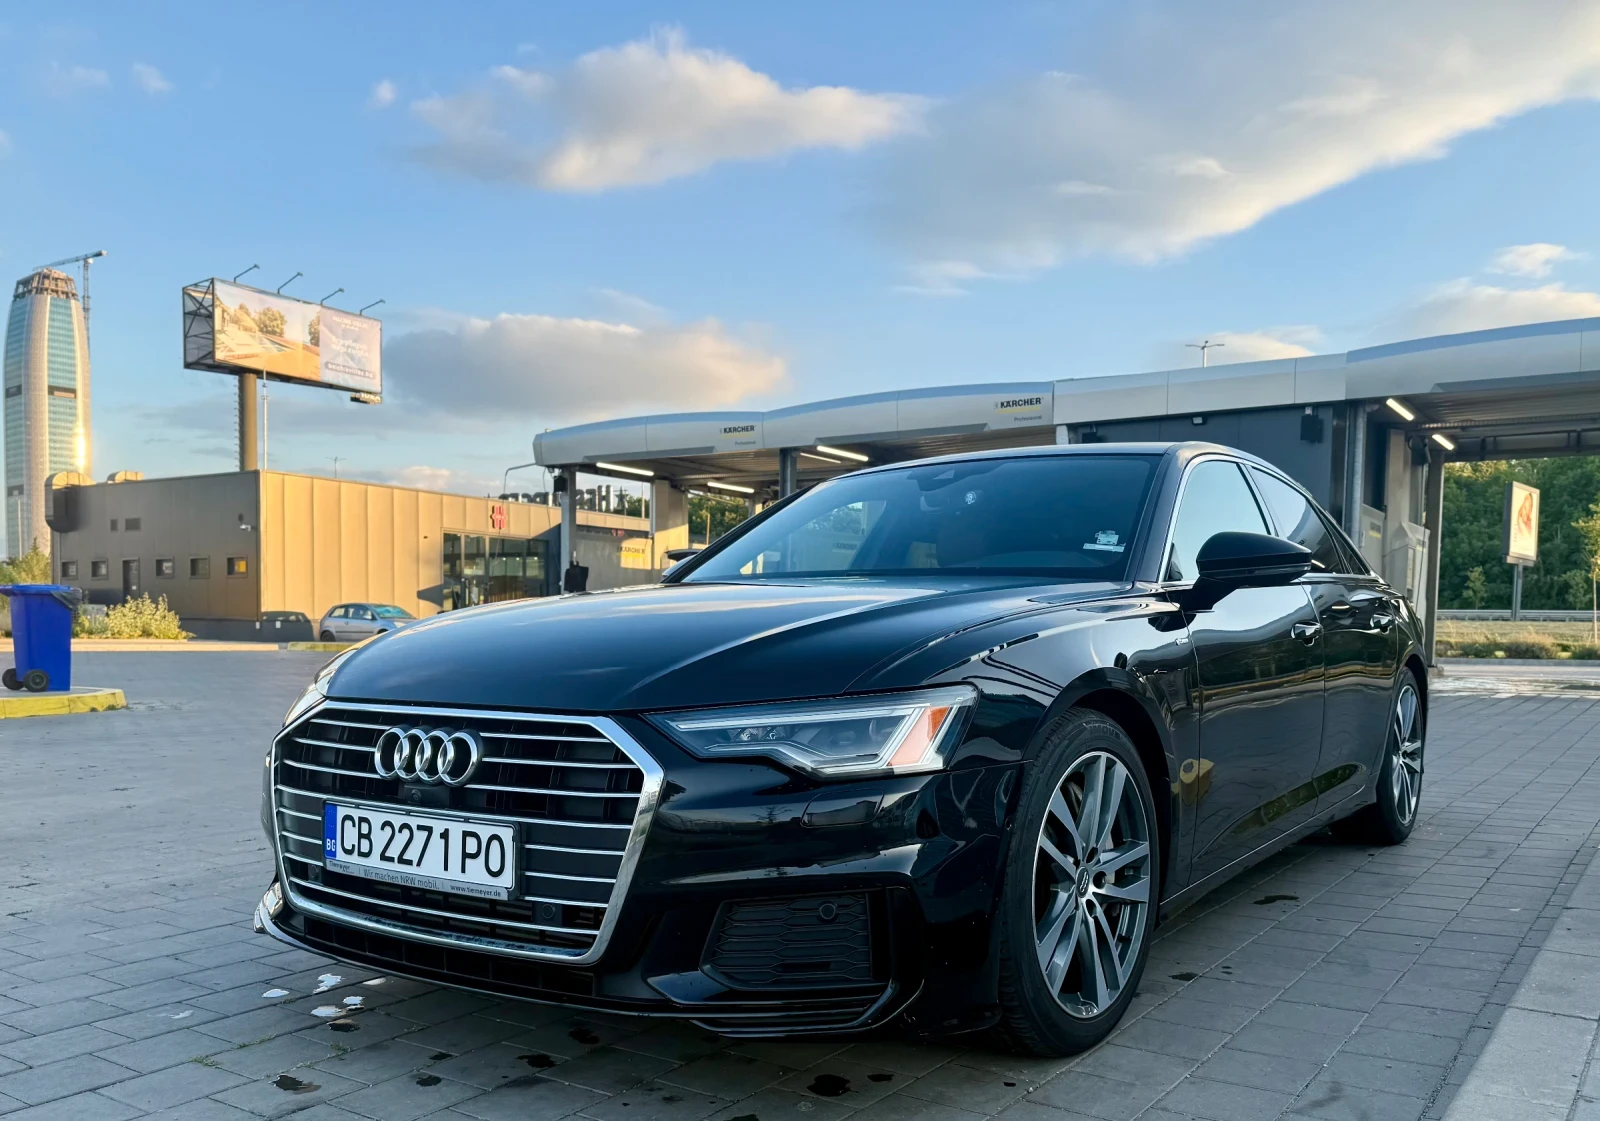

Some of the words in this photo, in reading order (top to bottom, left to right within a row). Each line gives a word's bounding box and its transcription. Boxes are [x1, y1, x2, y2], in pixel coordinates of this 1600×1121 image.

[1000, 397, 1041, 408] KÄRCHER
[724, 425, 754, 434] KÄRCHER
[326, 838, 336, 852] BG
[340, 813, 373, 858] CB
[379, 820, 450, 872] 2271
[363, 868, 374, 878] Wir
[375, 871, 399, 883] machen
[400, 875, 417, 886] NRW
[449, 884, 502, 898] www.tiemeyer.de
